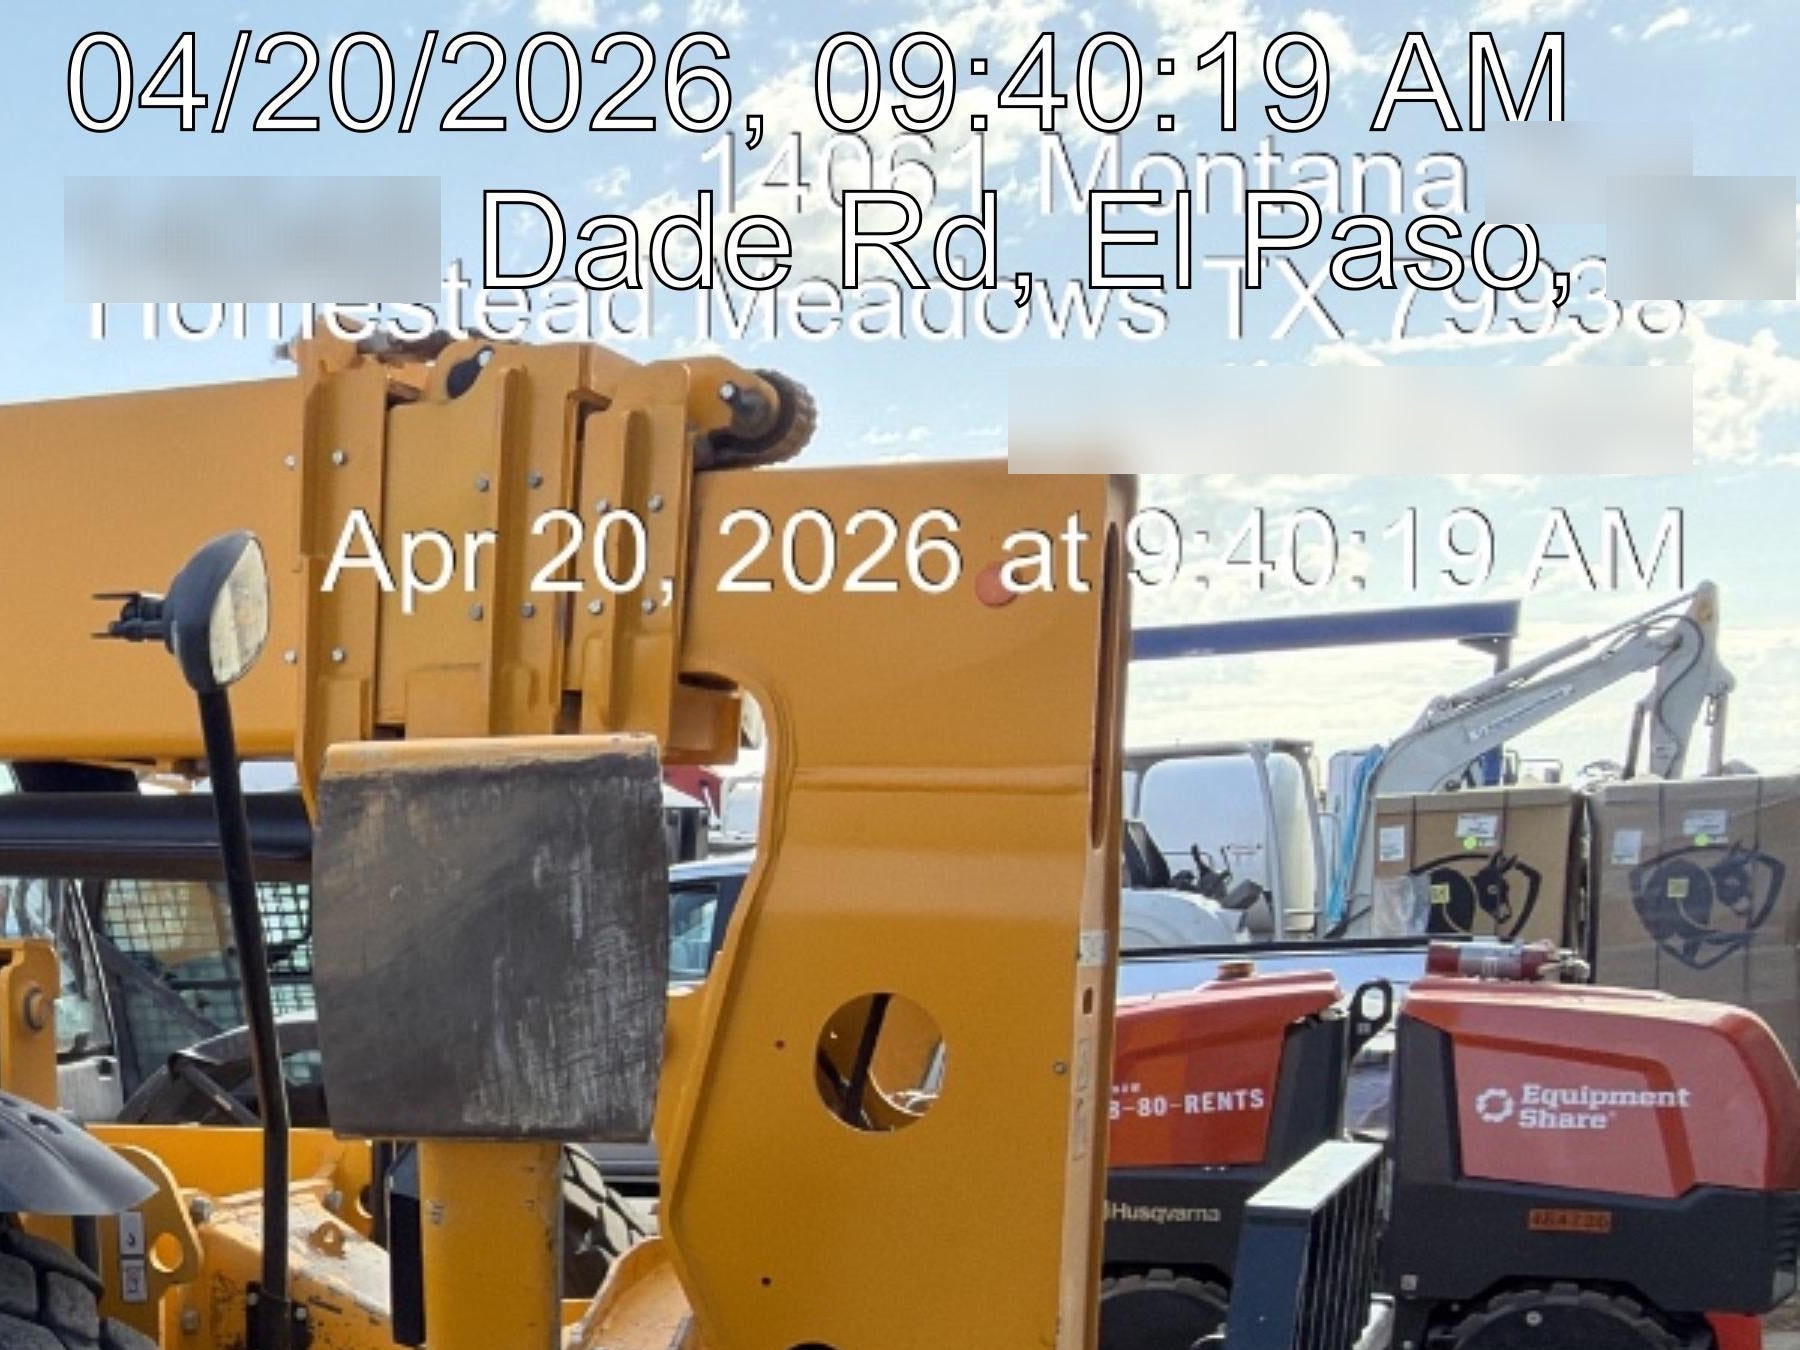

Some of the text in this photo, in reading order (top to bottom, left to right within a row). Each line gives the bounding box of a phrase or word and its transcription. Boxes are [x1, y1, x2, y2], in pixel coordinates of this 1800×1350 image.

[1519, 1084, 1691, 1111] Equipment
[1519, 1109, 1609, 1129] Share
[1111, 1202, 1222, 1224] Husqvarna
